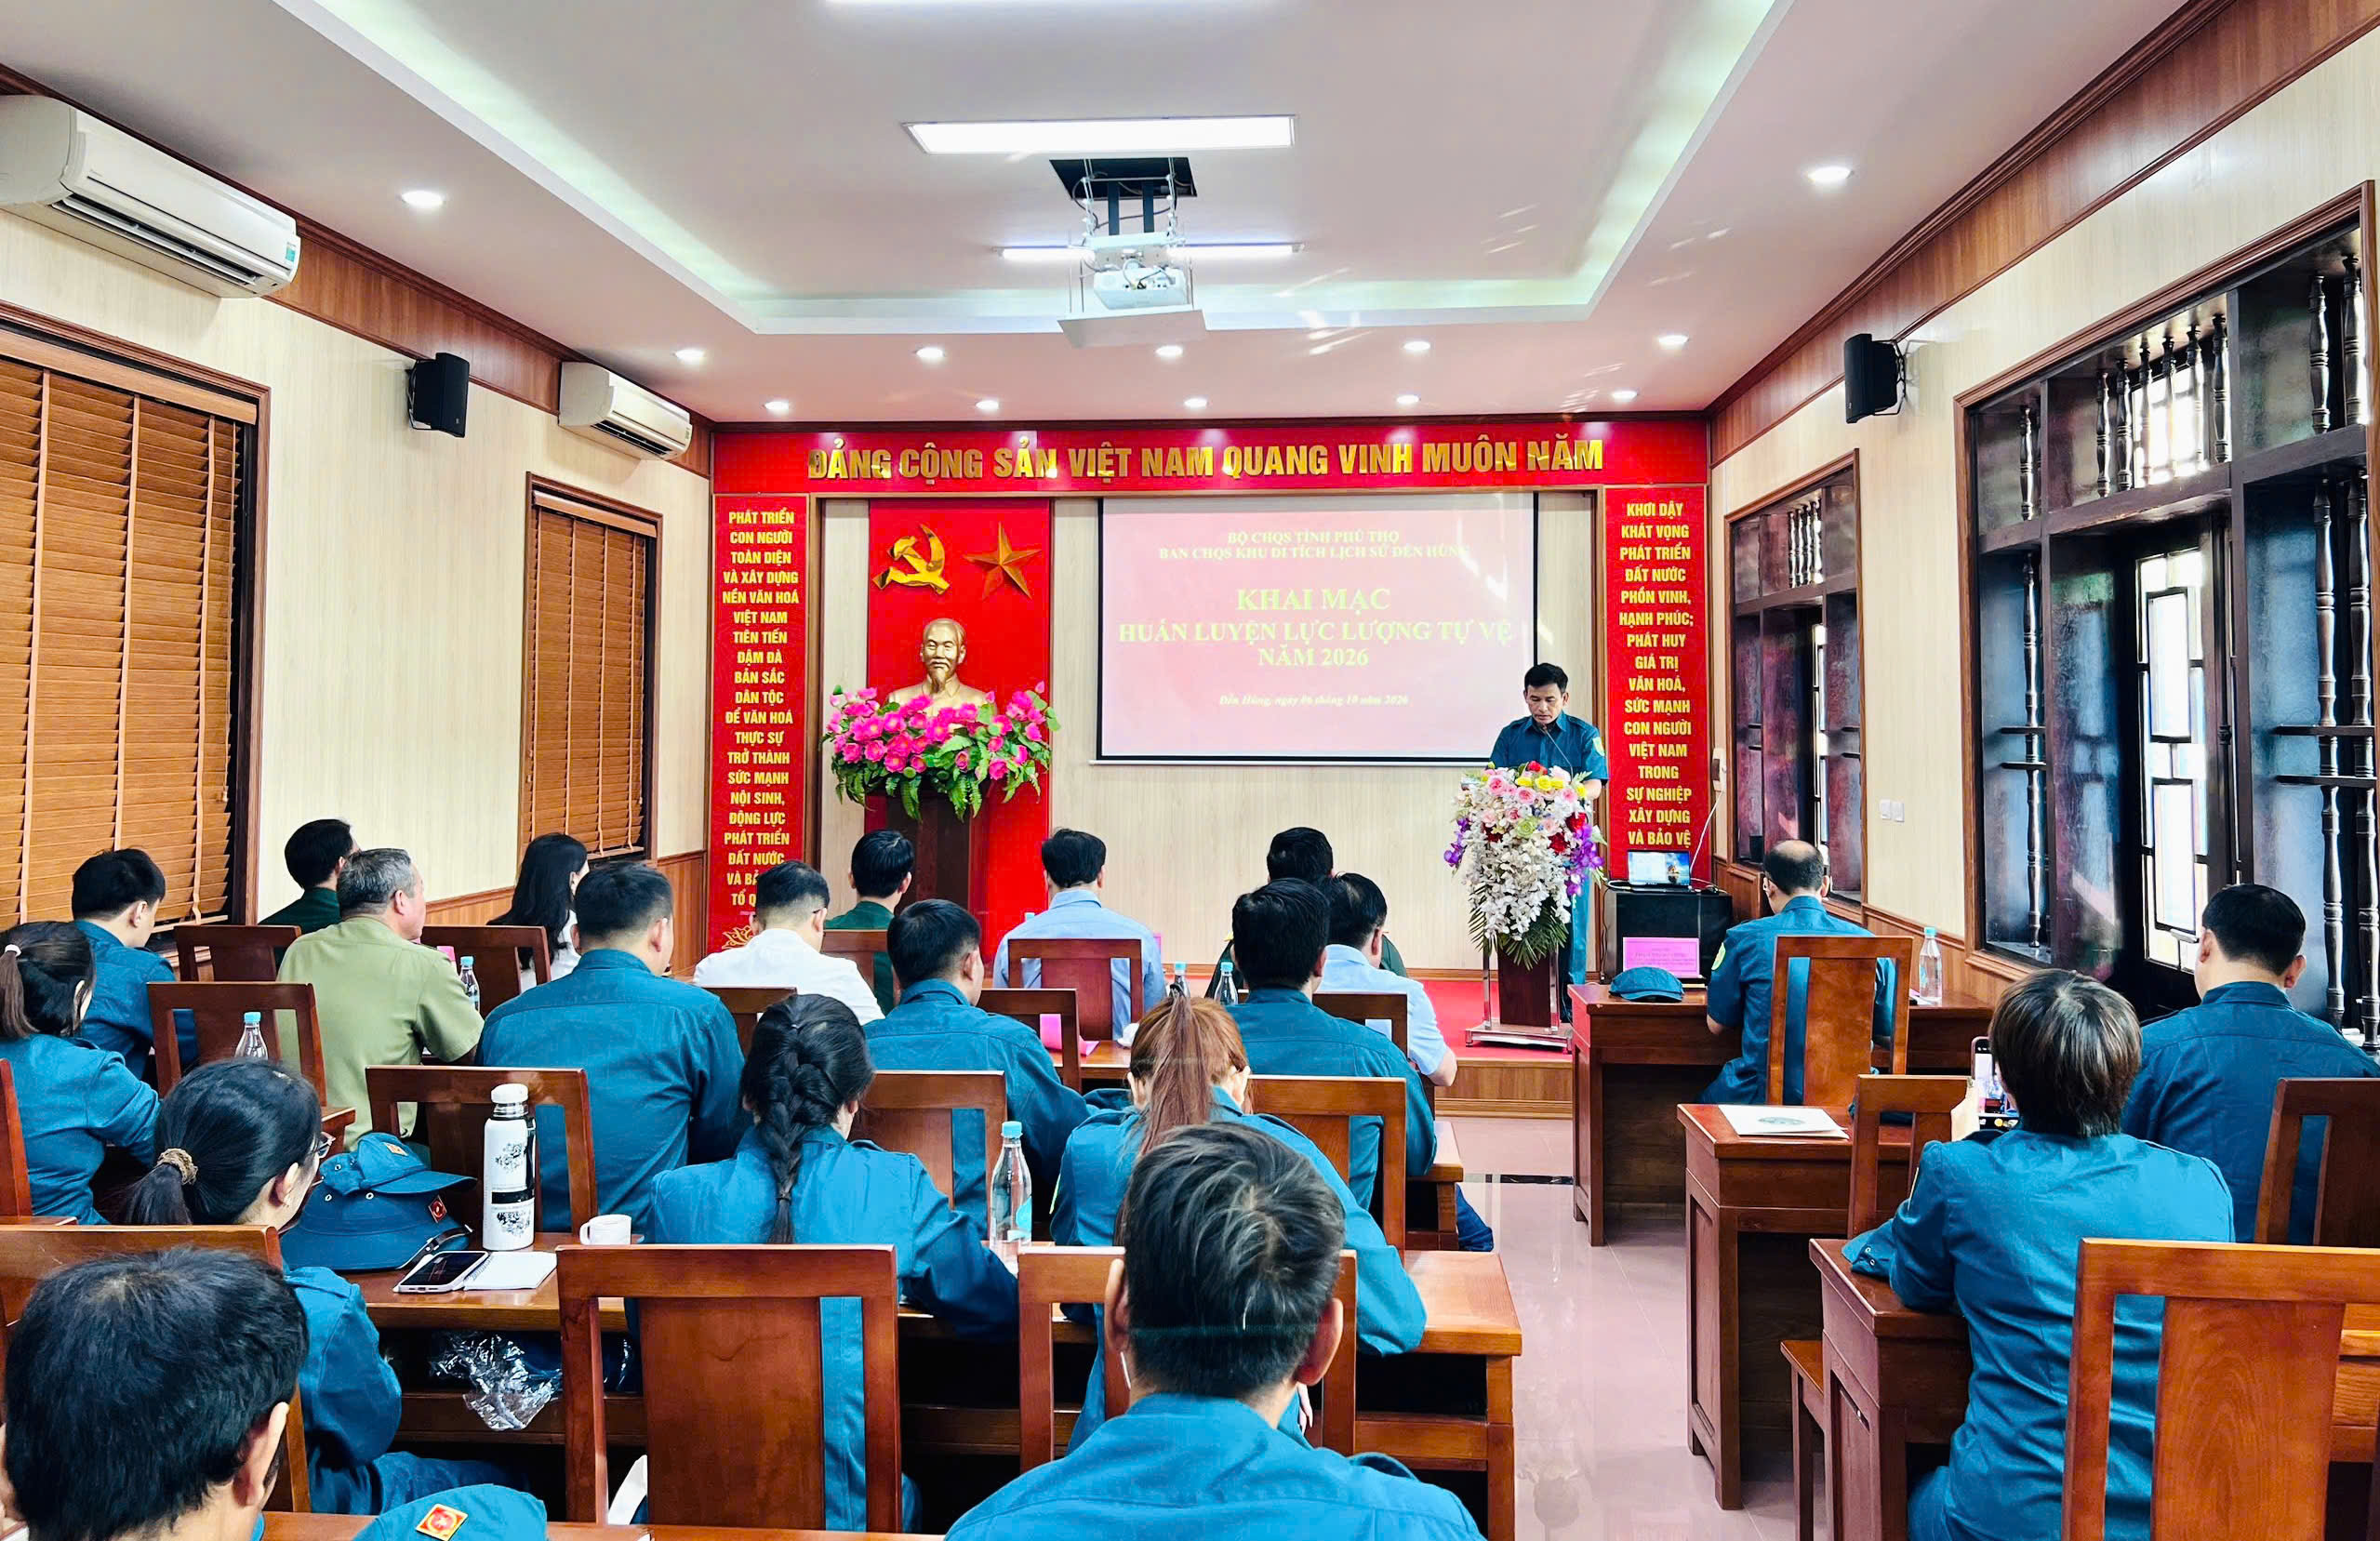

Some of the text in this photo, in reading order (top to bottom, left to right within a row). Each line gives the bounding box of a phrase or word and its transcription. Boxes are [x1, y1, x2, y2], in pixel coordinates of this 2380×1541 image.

[807, 432, 1603, 485] ĐẢNG CỘNG SẢN VIỆT NAM QUANG VINH MUÔN NĂM
[728, 507, 795, 524] PHÁT TRIỂN
[1626, 500, 1684, 519] KHƠI DẬY
[729, 529, 793, 543] CON NGƯỜI
[1228, 531, 1248, 546] BỘ
[1251, 531, 1292, 546] CHQS
[1621, 523, 1690, 540] KHÁT VỌNG
[730, 550, 792, 566] TOÀN DIỆN
[1160, 547, 1189, 559] BAN
[1191, 547, 1232, 561] CHQS
[1235, 547, 1267, 559] KHU
[1271, 547, 1287, 559] DI
[1330, 546, 1366, 562] LỊCH
[1619, 542, 1691, 560] PHÁT TRIỂN
[723, 569, 799, 586] VÀ XÂY DỰNG
[1625, 565, 1686, 581] ĐẤT NƯỚC
[749, 590, 773, 604] VĂN
[775, 590, 800, 604] HOÁ
[1235, 588, 1391, 616] KHAI MẠC
[1657, 591, 1692, 604] VINH,
[733, 609, 788, 626] VIỆT NAM
[1618, 610, 1694, 628] HẠNH PHÚC;
[732, 629, 788, 644] TIÊN TIẾN
[1194, 619, 1277, 645] LUYỆN
[1283, 619, 1336, 645] LỰC
[1342, 619, 1432, 645] LƯỢNG
[1437, 619, 1474, 645] TỰ
[1479, 619, 1513, 645] VỆ
[1627, 632, 1686, 647] PHÁT HUY
[737, 649, 783, 666] ĐẬM ĐÀ
[1256, 644, 1370, 666] NĂM 2026
[1634, 654, 1679, 671] GIÁ TRỊ
[734, 668, 786, 684] BẢN SẮC
[1628, 675, 1686, 692] VĂN HOÁ,
[735, 689, 784, 706] DÂN TỘC
[1624, 697, 1691, 715] SỨC MẠNH
[725, 707, 793, 724] ĐỂ VĂN HOÁ
[1623, 719, 1692, 735] CON NGƯỜI
[734, 731, 785, 746] THỰC SỰ
[726, 749, 791, 764] TRỞ THÀNH
[1629, 741, 1688, 759] VIỆT NAM
[727, 770, 790, 786] SỨC MẠNH
[1637, 765, 1680, 778] TRONG
[730, 790, 785, 806] NỘI SINH,
[1626, 786, 1693, 804] SỰ NGHIỆP
[728, 810, 786, 827] ĐỘNG LỰC
[1629, 807, 1691, 825] XÂY DỰNG
[724, 829, 790, 844] PHÁT TRIỂN
[1628, 828, 1692, 848] VÀ BẢO VỆ
[728, 849, 785, 865] ĐẤT NƯỚC
[726, 870, 759, 884] VÀ BẢ
[731, 889, 746, 905] TỔ
